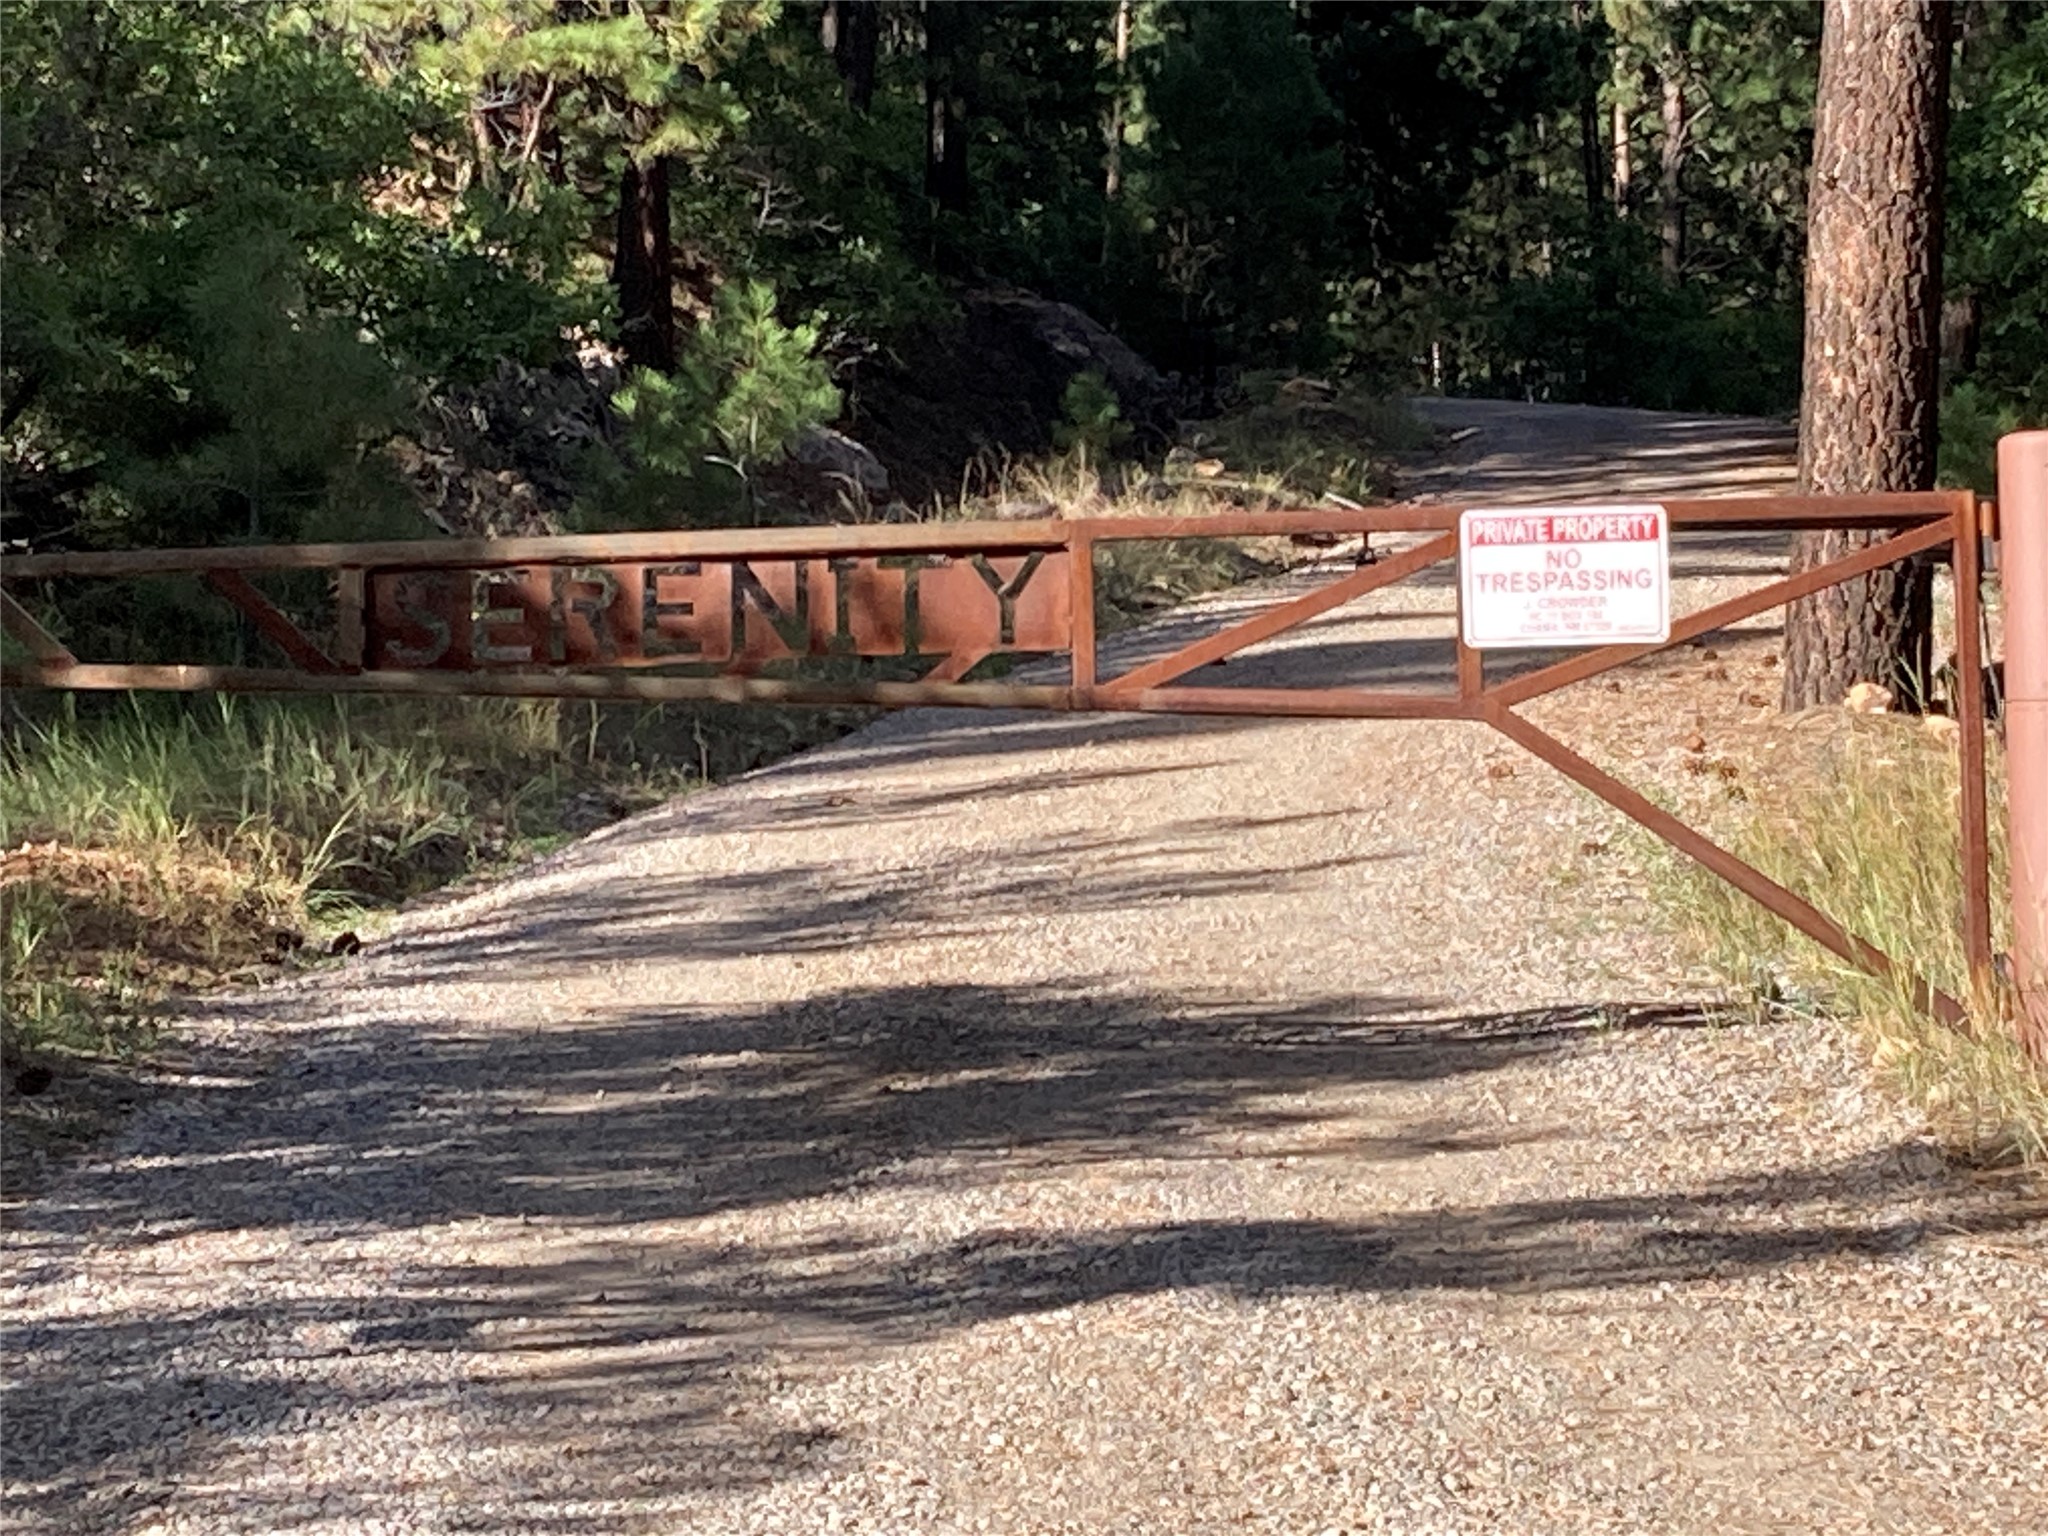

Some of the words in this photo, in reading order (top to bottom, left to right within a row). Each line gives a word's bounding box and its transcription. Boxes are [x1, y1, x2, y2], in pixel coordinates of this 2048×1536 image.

[1471, 519, 1549, 545] PRIVATE
[1553, 515, 1655, 541] PROPERTY
[1546, 548, 1582, 569] NO
[1476, 568, 1653, 593] TRESPASSING
[384, 551, 1046, 666] SERENITY
